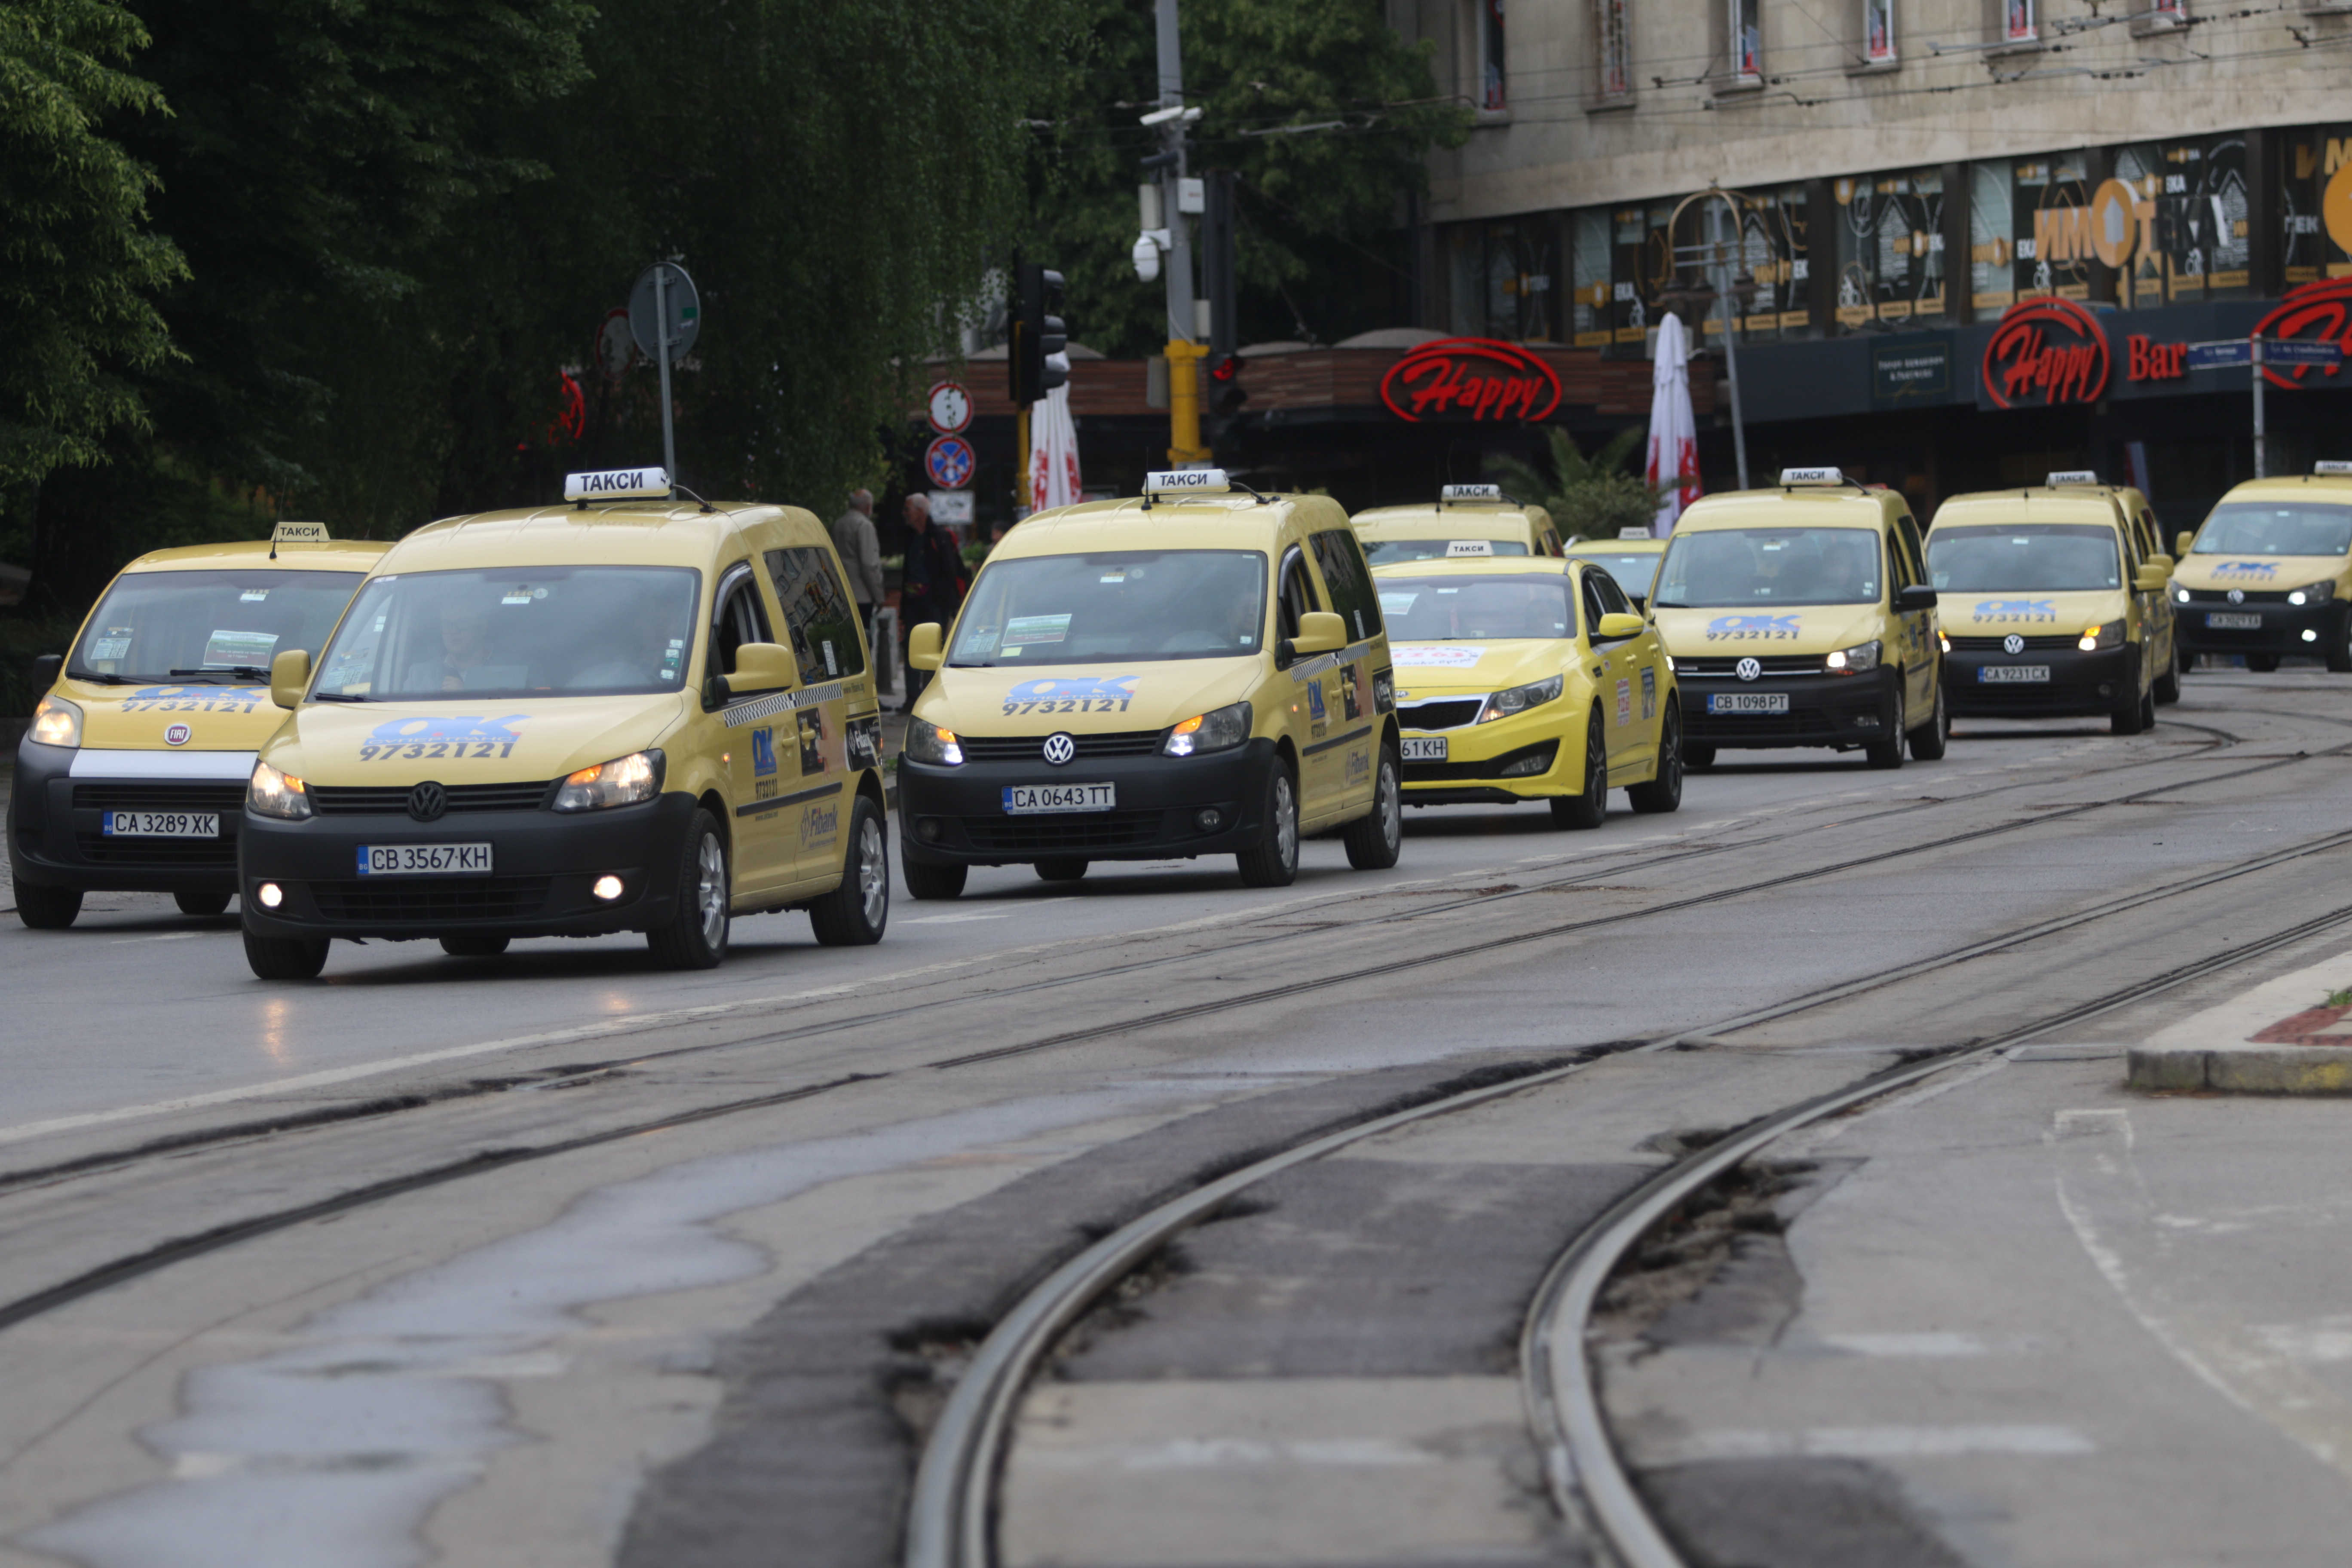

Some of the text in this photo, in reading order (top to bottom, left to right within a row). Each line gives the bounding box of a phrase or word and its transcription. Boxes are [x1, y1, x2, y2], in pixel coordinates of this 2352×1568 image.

[1997, 325, 2189, 404] Happy Bar
[1403, 356, 1545, 421] Happy
[581, 472, 643, 492] ТАКСИ
[1160, 473, 1207, 487] ТАКСИ
[1791, 471, 1825, 480] ТАКСИ
[1452, 486, 1490, 497] ТАКСИ
[280, 527, 320, 536] ТАКСИ
[1973, 613, 2055, 623] 9732121
[1706, 631, 1800, 641] 9732121
[1985, 669, 2000, 680] CA
[2002, 669, 2029, 680] 9231
[1008, 693, 1128, 702] СУПЕРТРАНС
[1716, 695, 1786, 709] CB 1098 PT
[121, 701, 257, 714] 9732121
[1001, 699, 1130, 716] 9732121
[170, 729, 186, 739] FIAT
[368, 736, 512, 744] СУПЕРТРАНС
[359, 742, 514, 761] 9732121
[1423, 741, 1443, 756] KH
[1351, 747, 1369, 776] Fibank
[755, 778, 777, 800] 9732121
[1014, 787, 1111, 807] CA 0643 TT
[115, 814, 215, 834] CA 3289 XK
[810, 803, 838, 837] Fibank
[372, 847, 488, 870] CB 3567 KH
